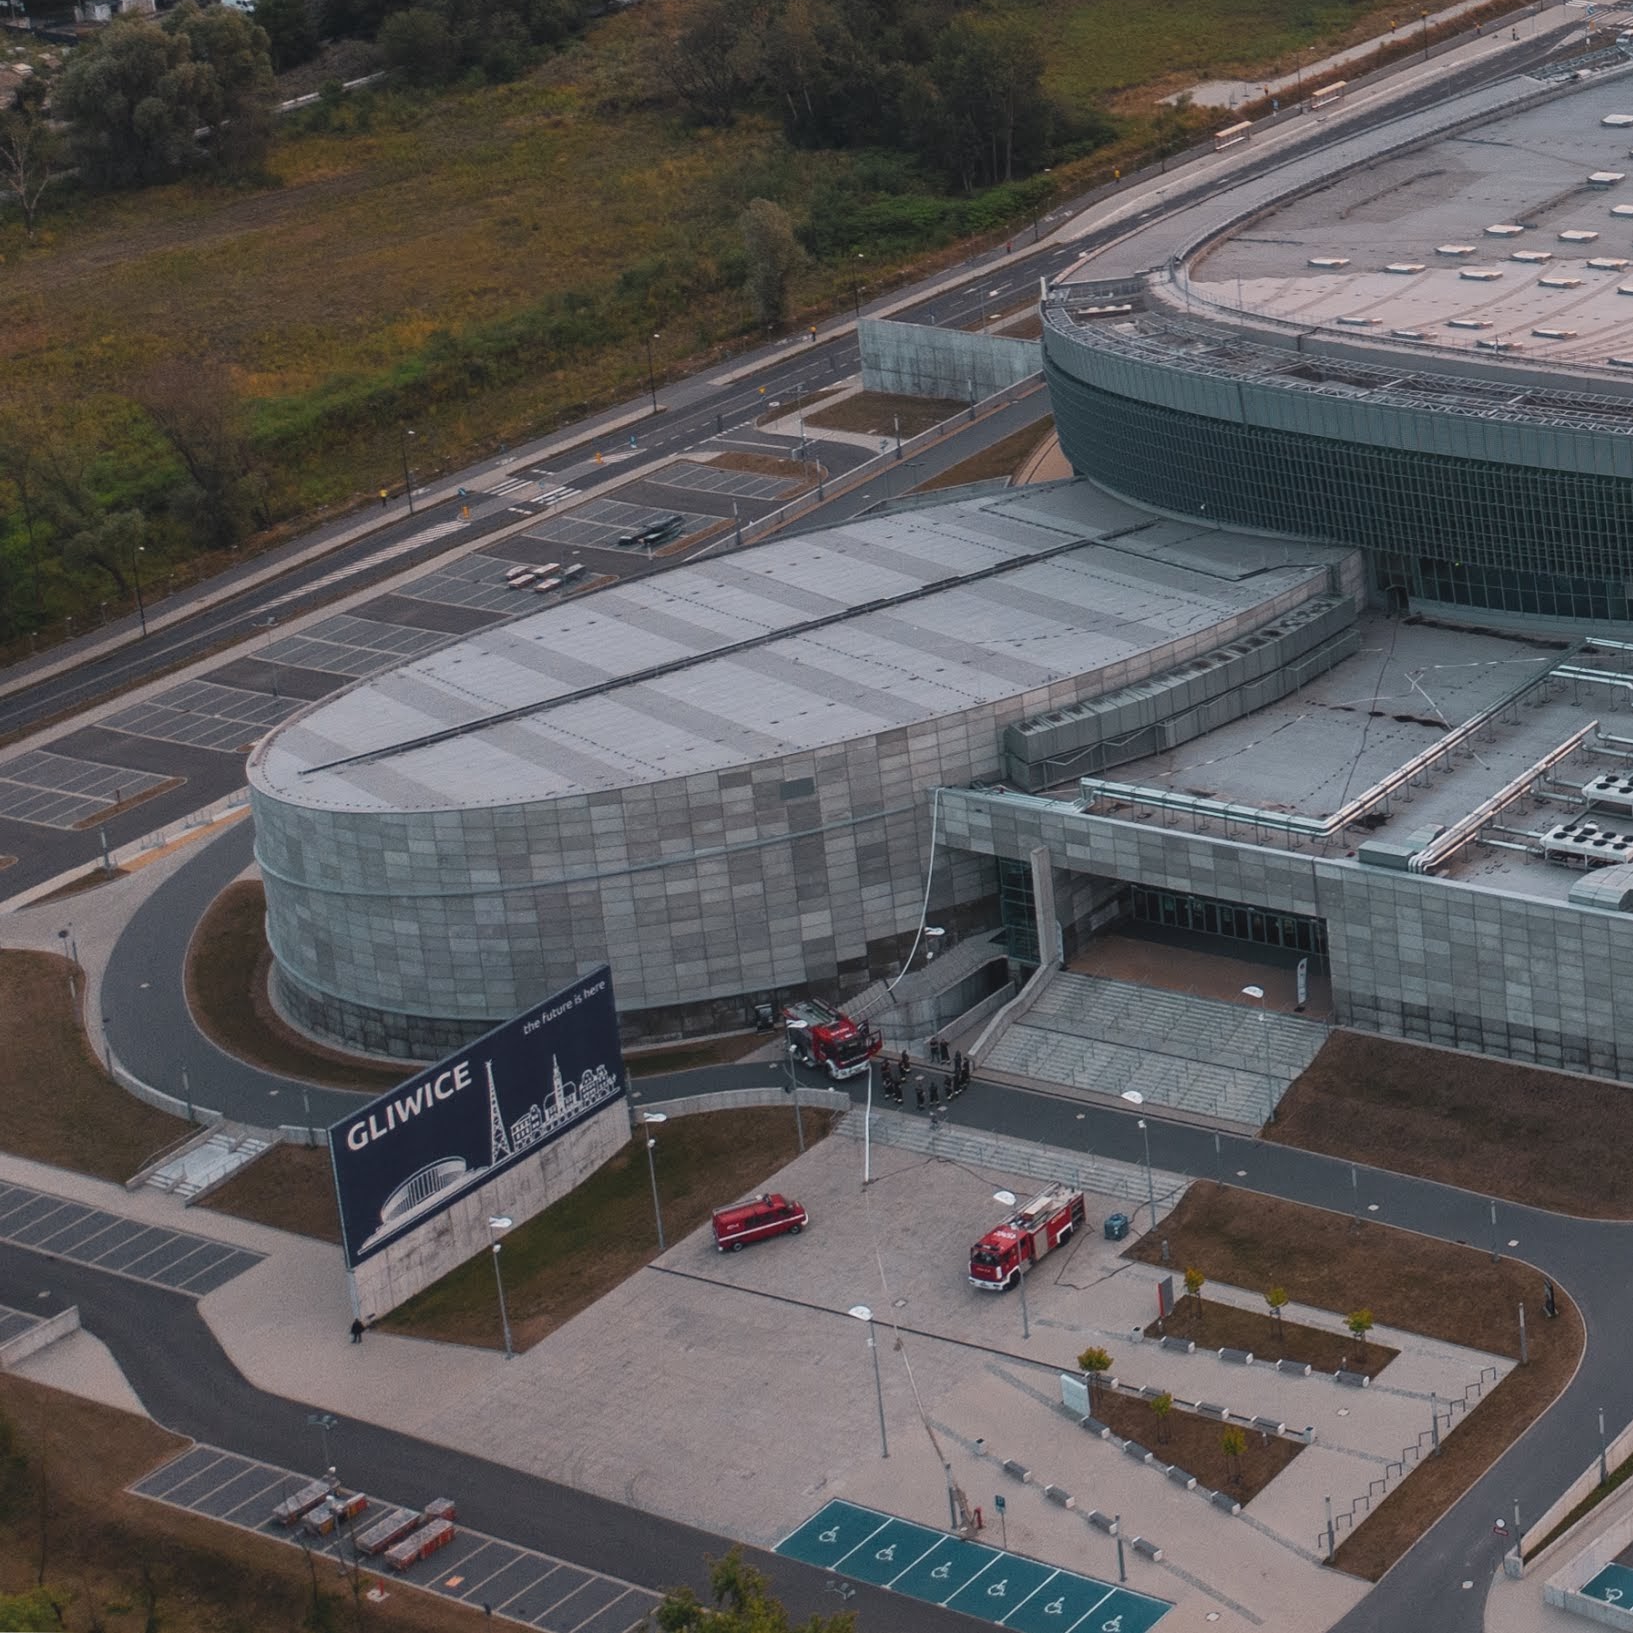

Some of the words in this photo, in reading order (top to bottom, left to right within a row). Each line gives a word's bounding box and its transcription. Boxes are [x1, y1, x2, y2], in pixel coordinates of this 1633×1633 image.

[523, 1019, 541, 1035] the
[542, 1000, 573, 1024] future
[573, 993, 582, 1005] is
[583, 981, 606, 999] here
[347, 1061, 473, 1151] GLIWICE
